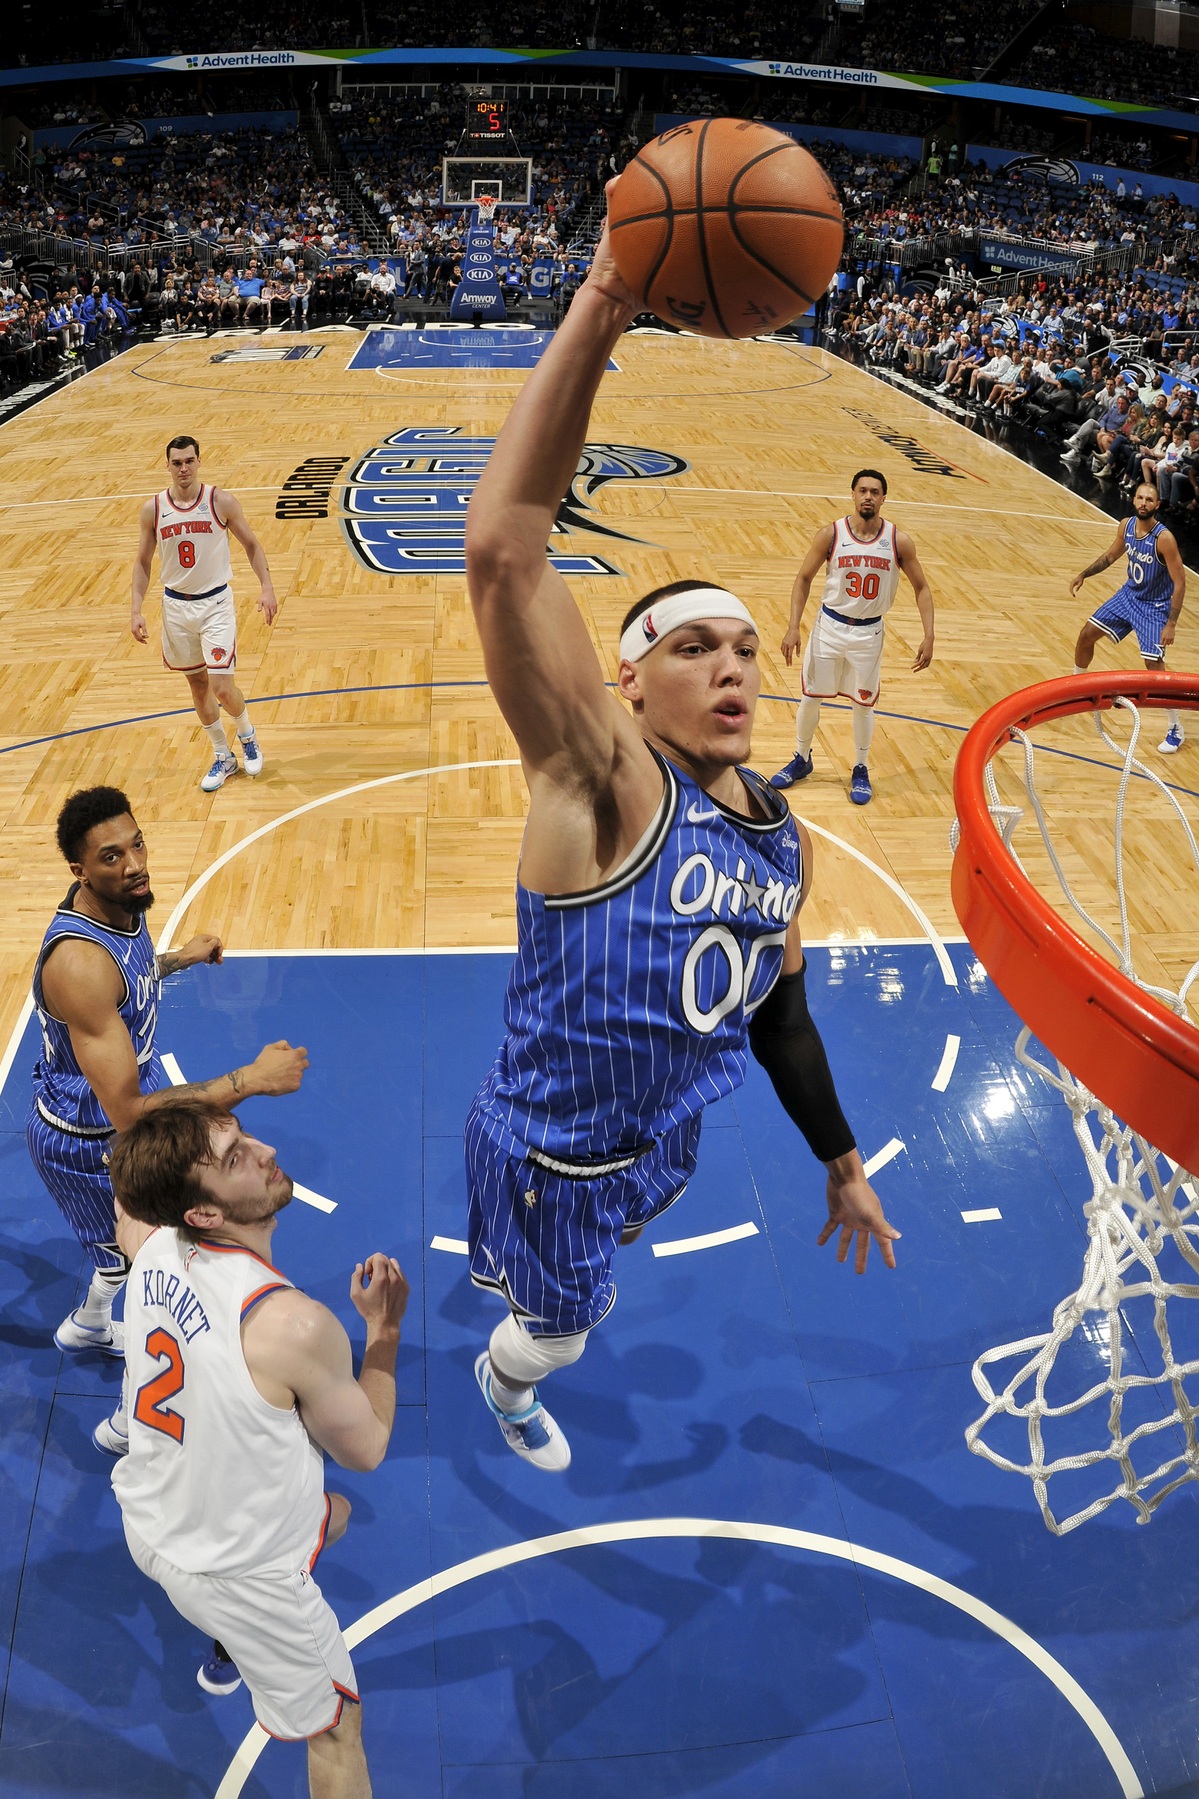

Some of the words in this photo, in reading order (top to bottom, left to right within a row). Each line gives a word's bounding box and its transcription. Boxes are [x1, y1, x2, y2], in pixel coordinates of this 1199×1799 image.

[477, 103, 504, 112] 10:41
[489, 112, 500, 131] 5
[1092, 173, 1104, 181] 112
[997, 248, 1082, 275] AdventHe
[460, 292, 497, 304] Amway
[275, 456, 351, 520] ORLANDO
[178, 541, 195, 568] 8
[838, 555, 862, 568] NEW
[862, 555, 891, 571] YORK
[846, 571, 880, 600] 30
[682, 924, 787, 1034] 00
[142, 1269, 211, 1346] KORNET
[132, 1326, 186, 1446] 2
